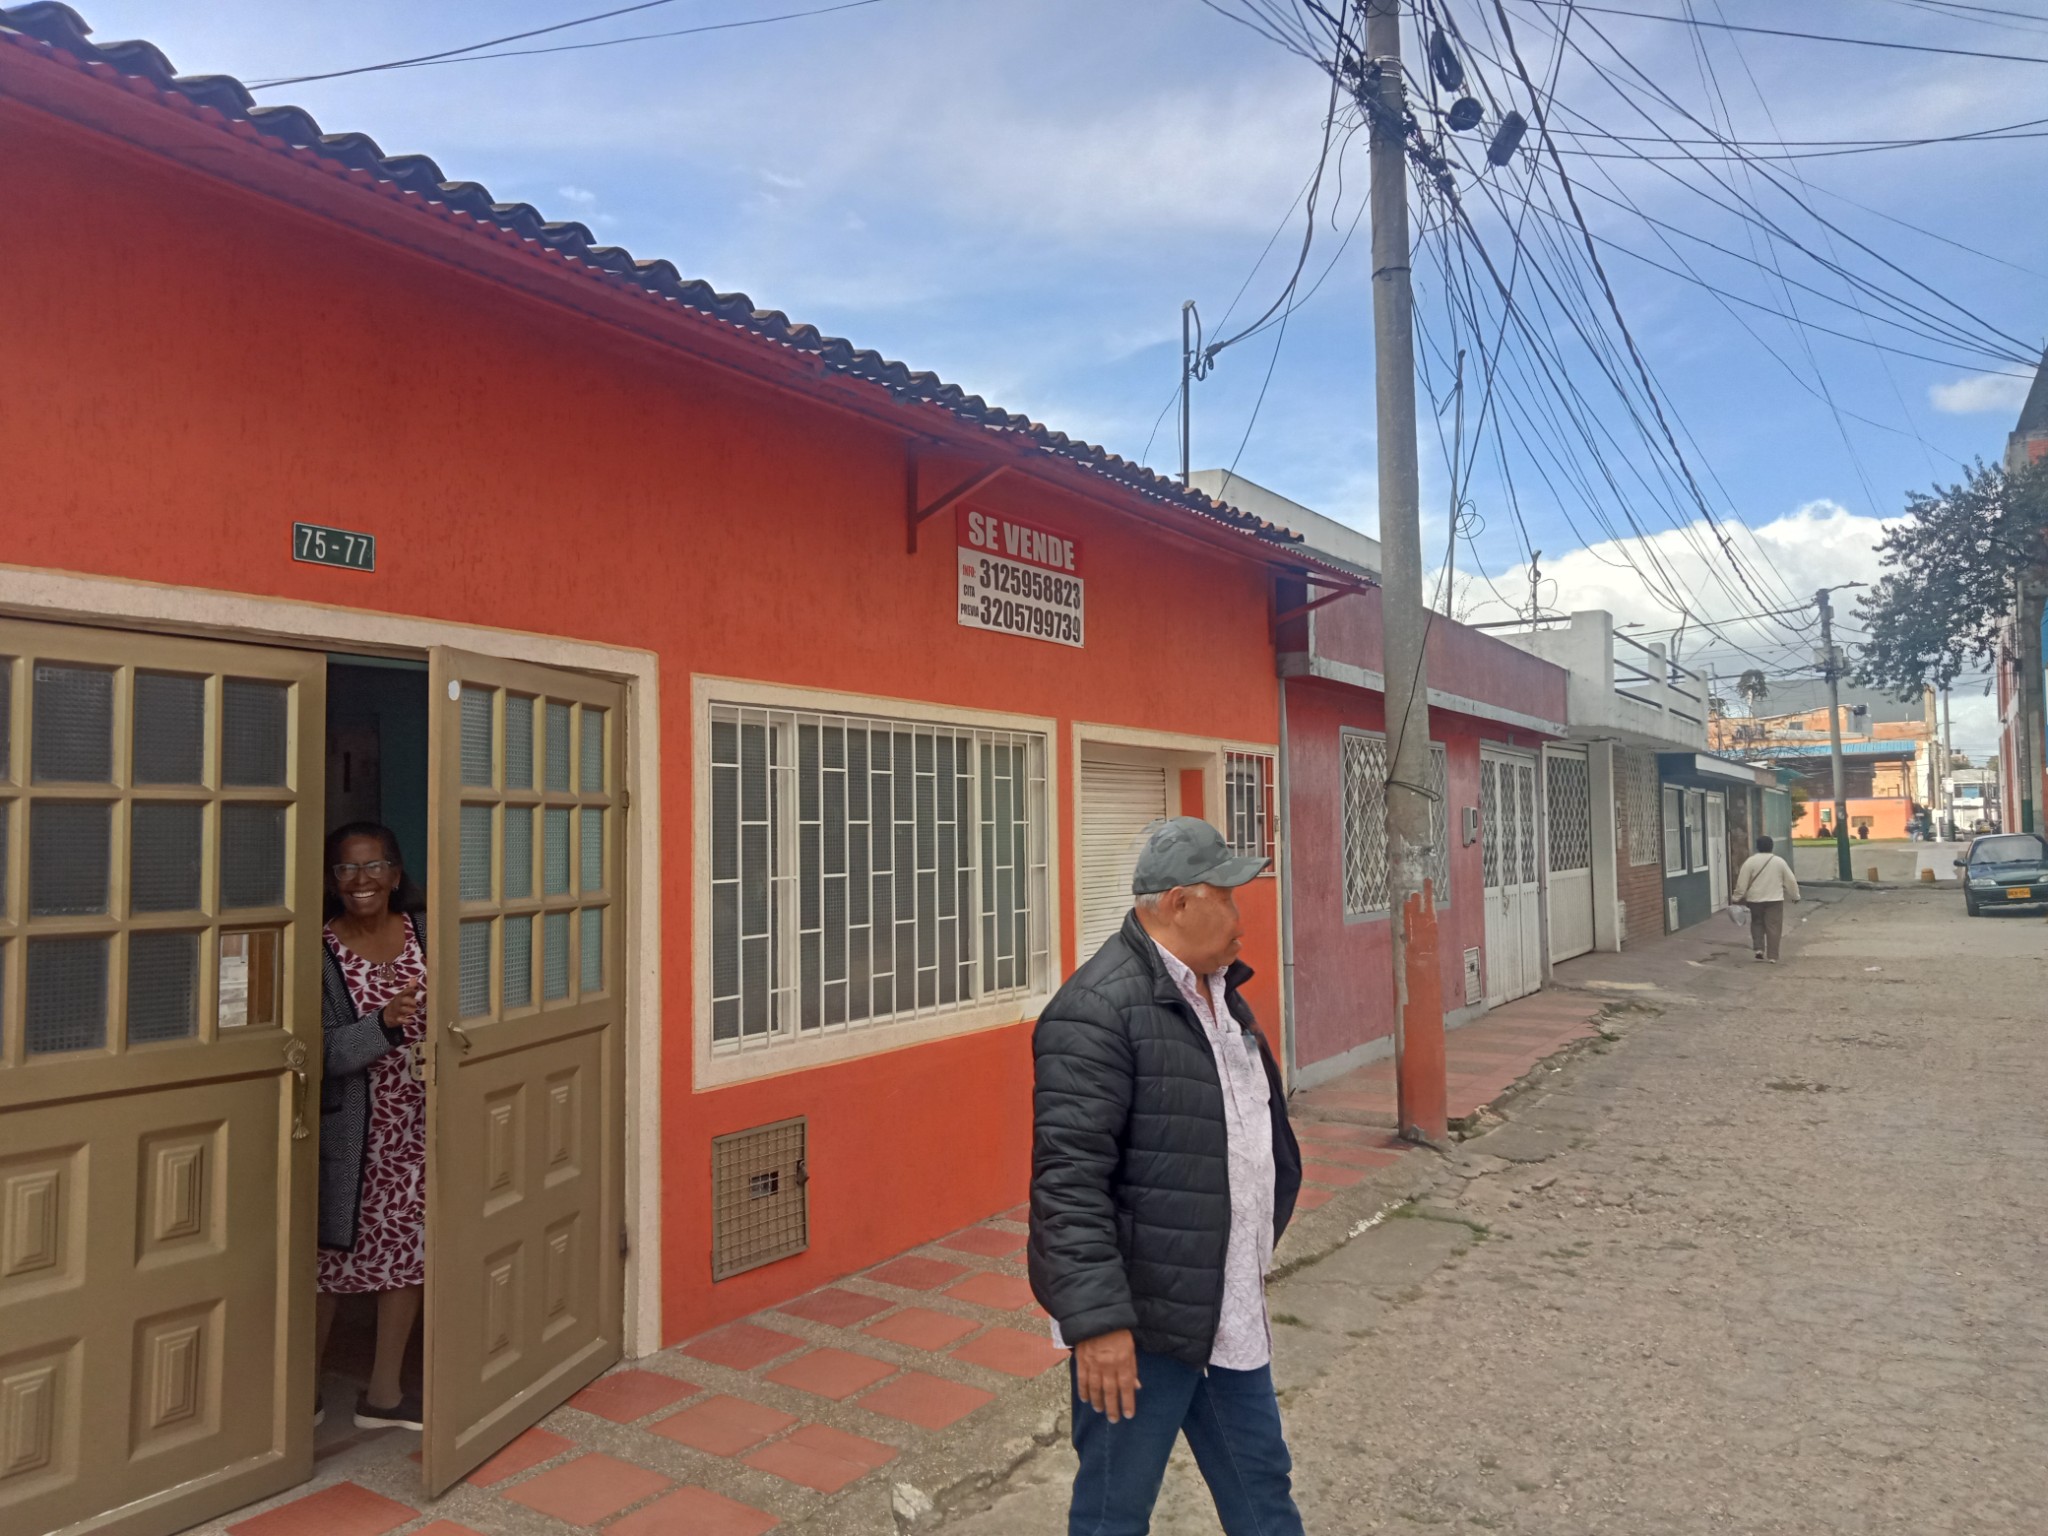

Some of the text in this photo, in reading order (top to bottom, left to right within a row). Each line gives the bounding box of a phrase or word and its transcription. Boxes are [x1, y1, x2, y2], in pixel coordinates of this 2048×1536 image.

[301, 528, 368, 565] 75-77
[968, 511, 1075, 571] SE VENDE
[963, 584, 976, 598] CITA
[980, 558, 1081, 610] 3125958823
[960, 603, 980, 618] PREVIA
[980, 595, 1081, 643] 3205799739
